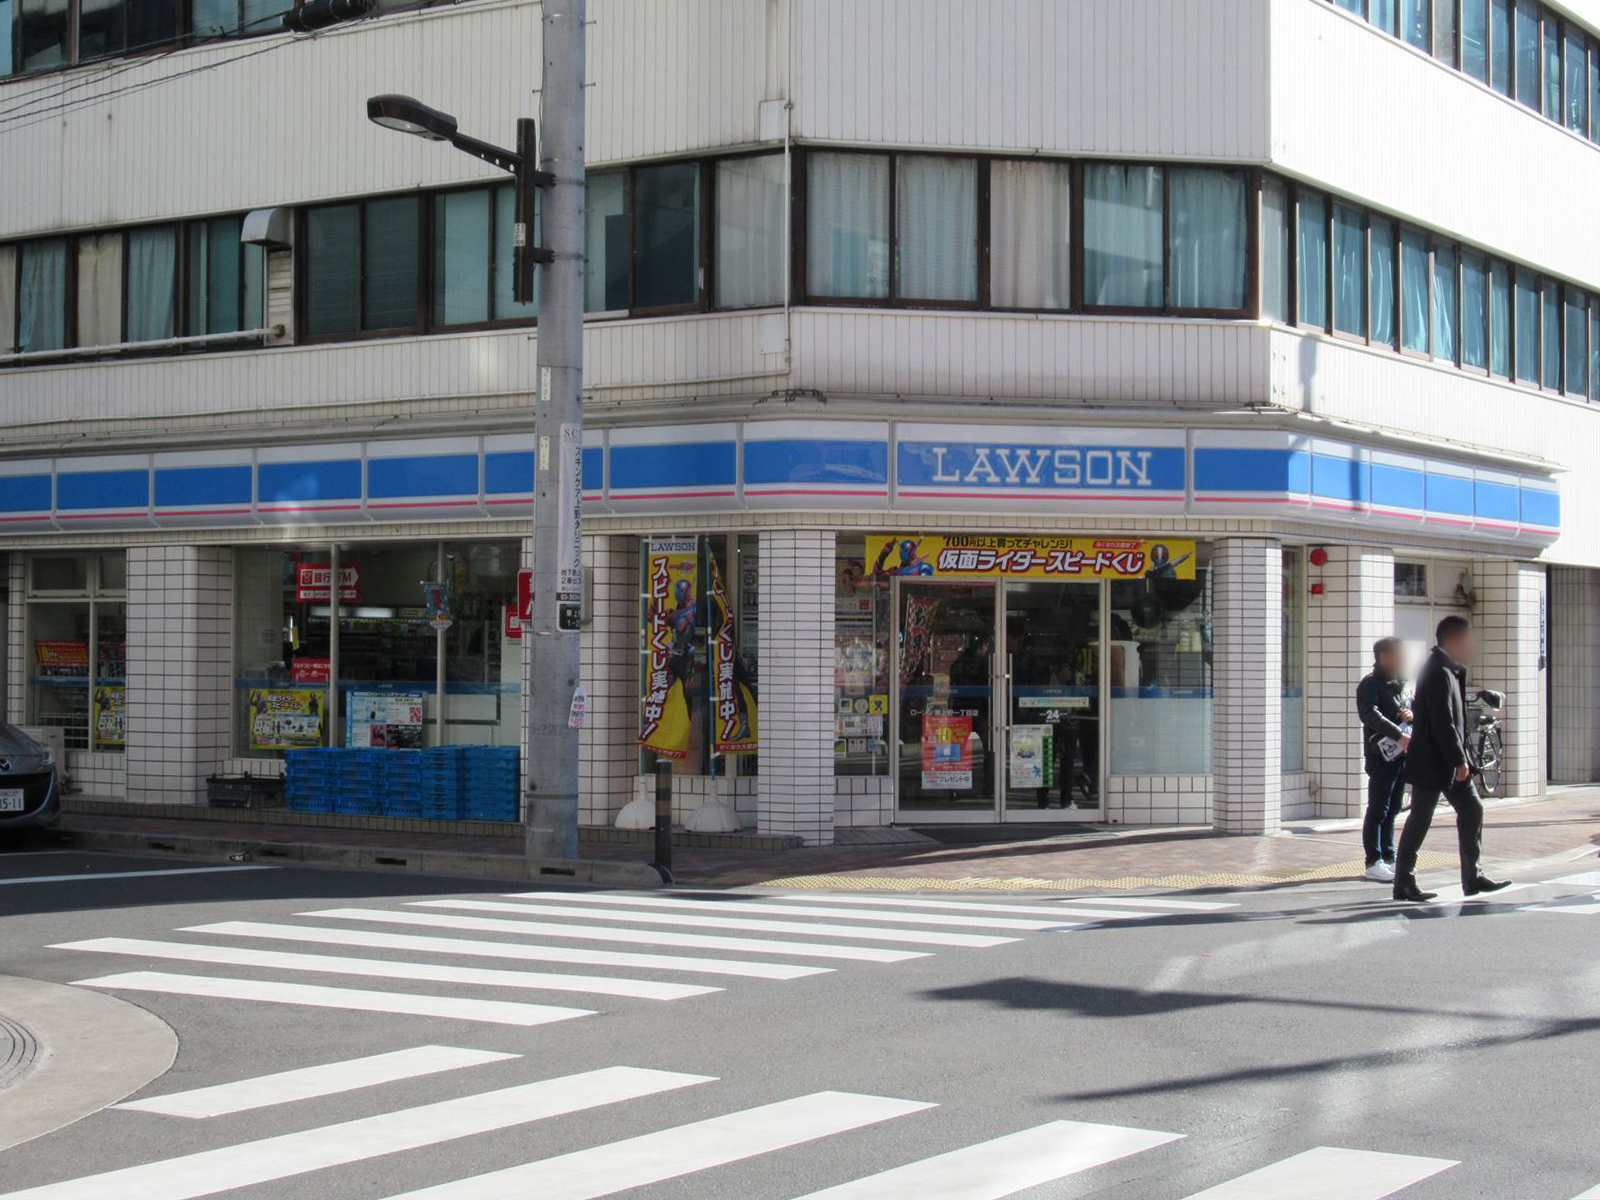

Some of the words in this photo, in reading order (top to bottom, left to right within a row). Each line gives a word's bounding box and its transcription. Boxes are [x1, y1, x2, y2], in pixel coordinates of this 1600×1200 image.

[932, 447, 1152, 485] LAWSON
[650, 542, 696, 552] LAWSON
[938, 550, 1143, 573] 仮面ライダースピードくじ
[642, 558, 668, 739] スピードくじ実施中!
[1046, 709, 1060, 720] 24
[935, 727, 952, 744] 10
